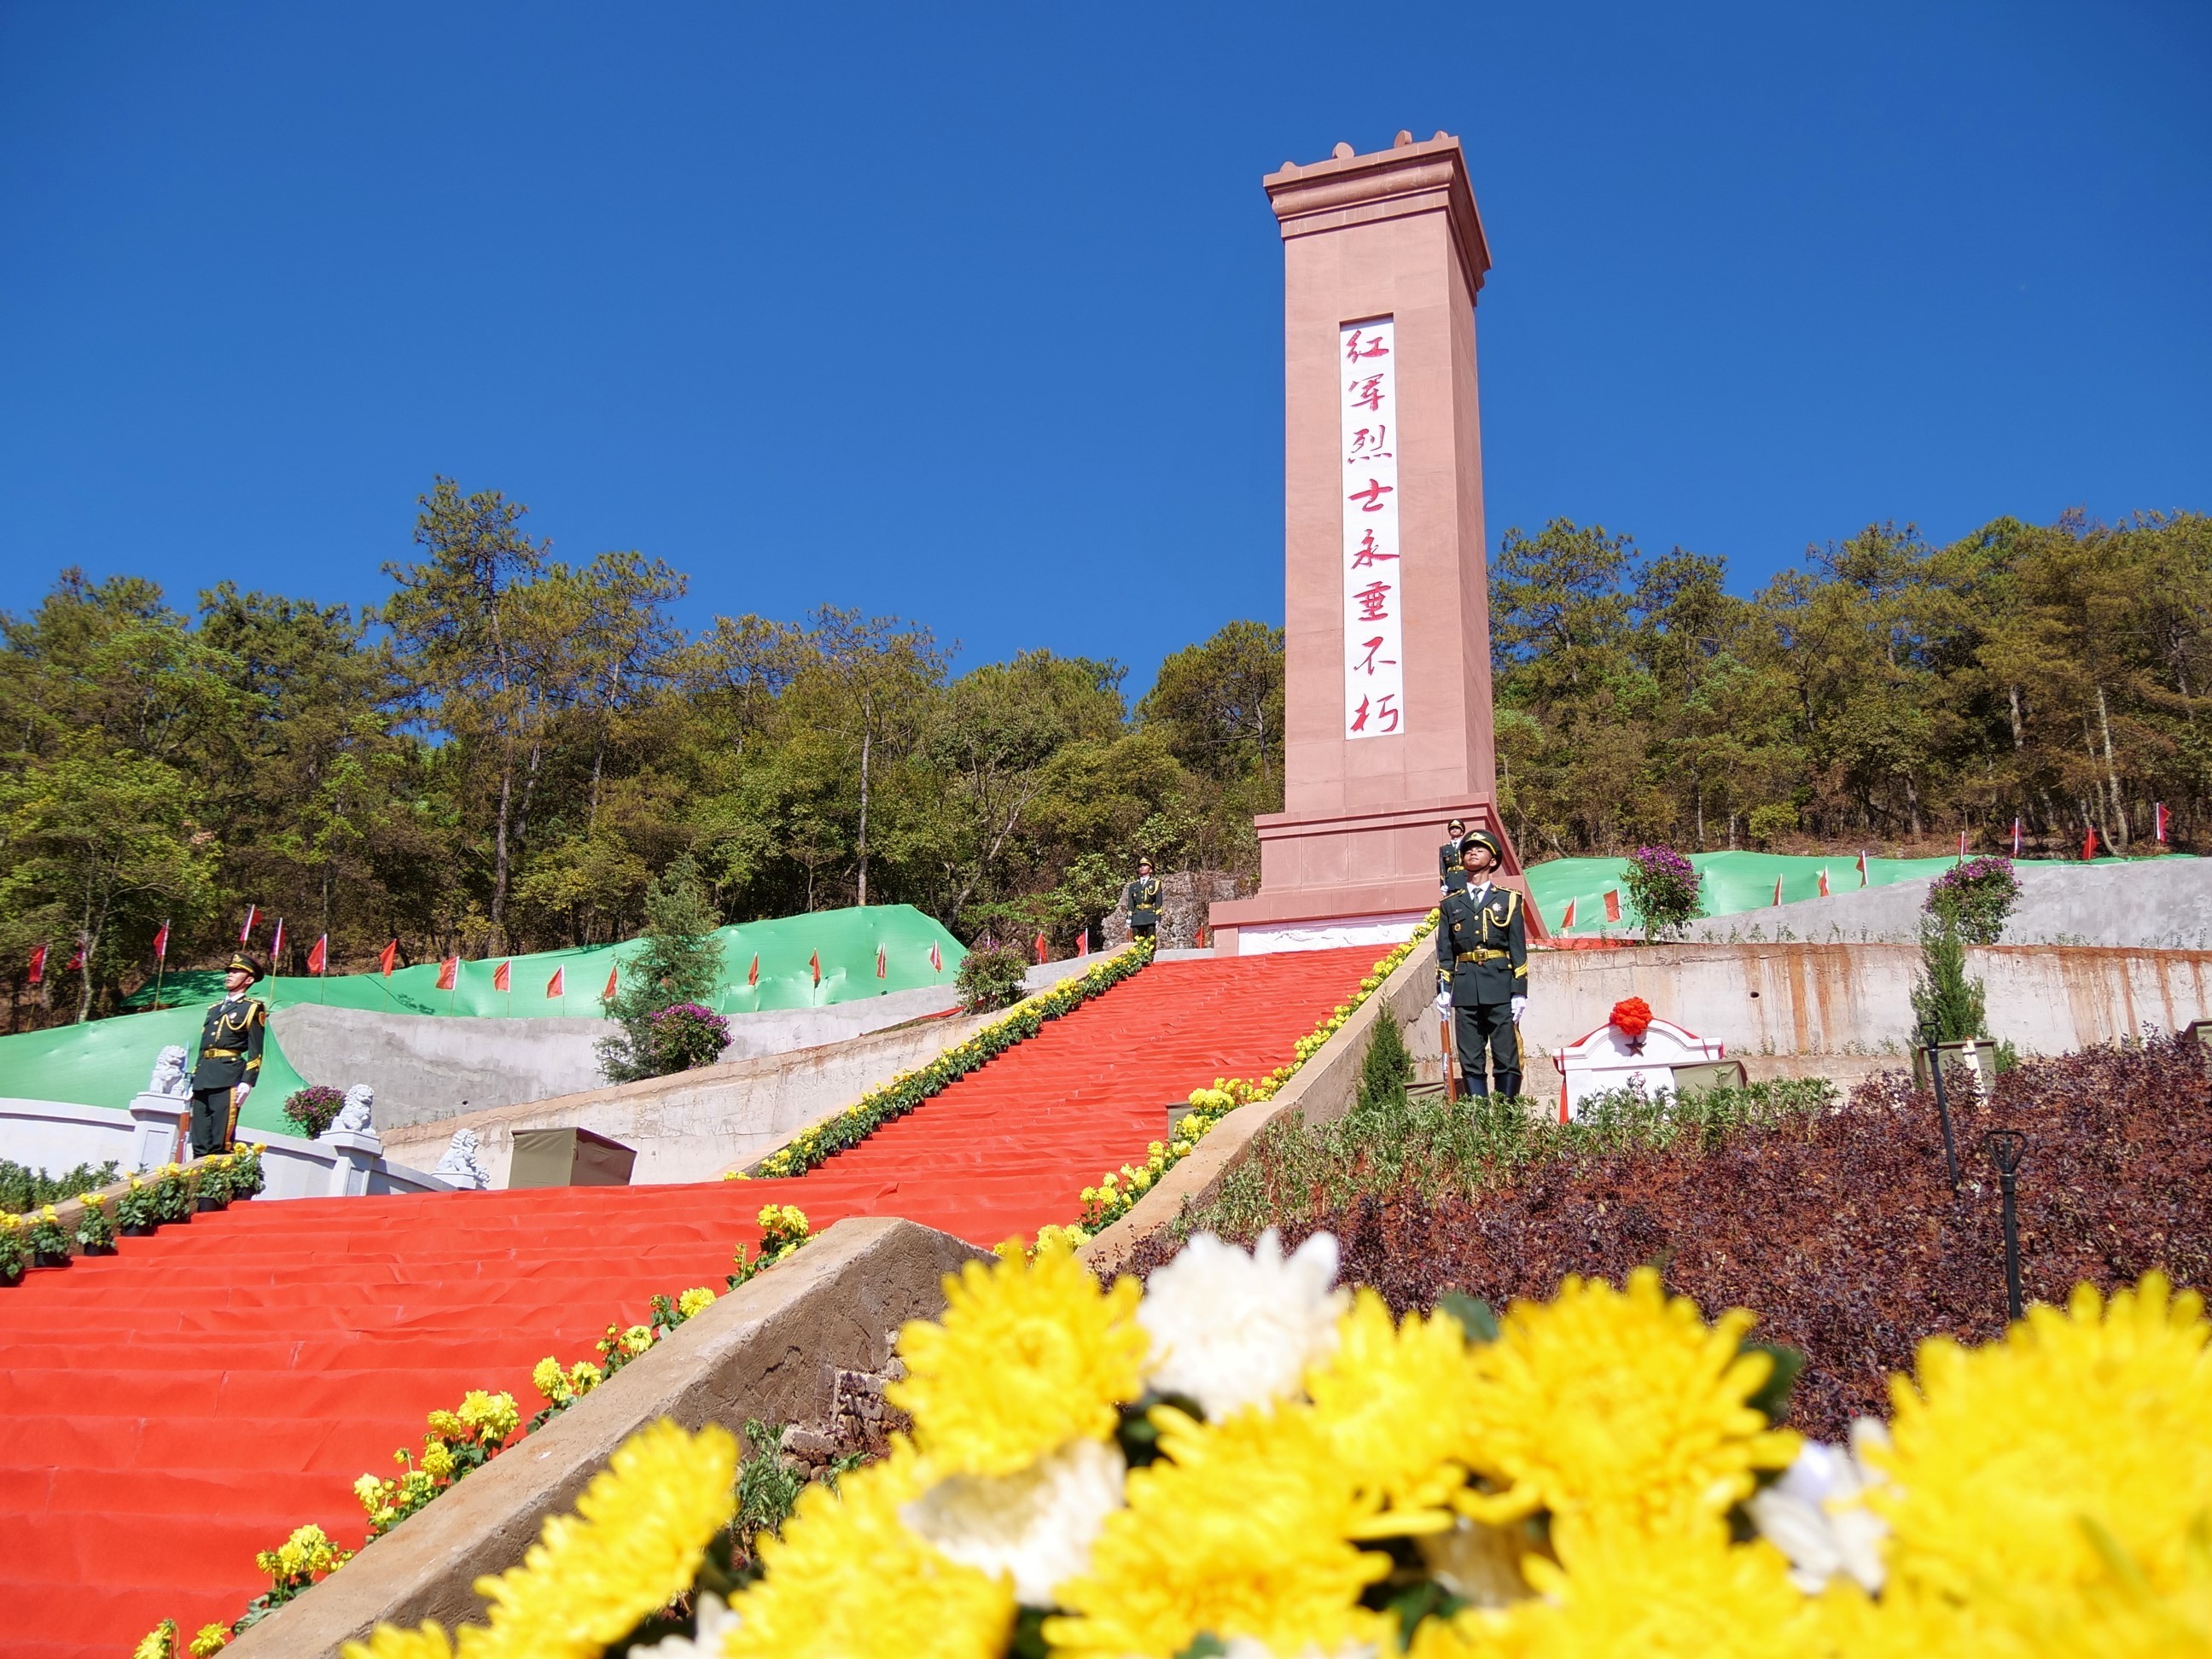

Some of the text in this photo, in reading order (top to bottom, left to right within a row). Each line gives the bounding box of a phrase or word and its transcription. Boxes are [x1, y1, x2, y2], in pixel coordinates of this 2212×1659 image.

[1346, 329, 1400, 732] 红军烈士永垂不朽
